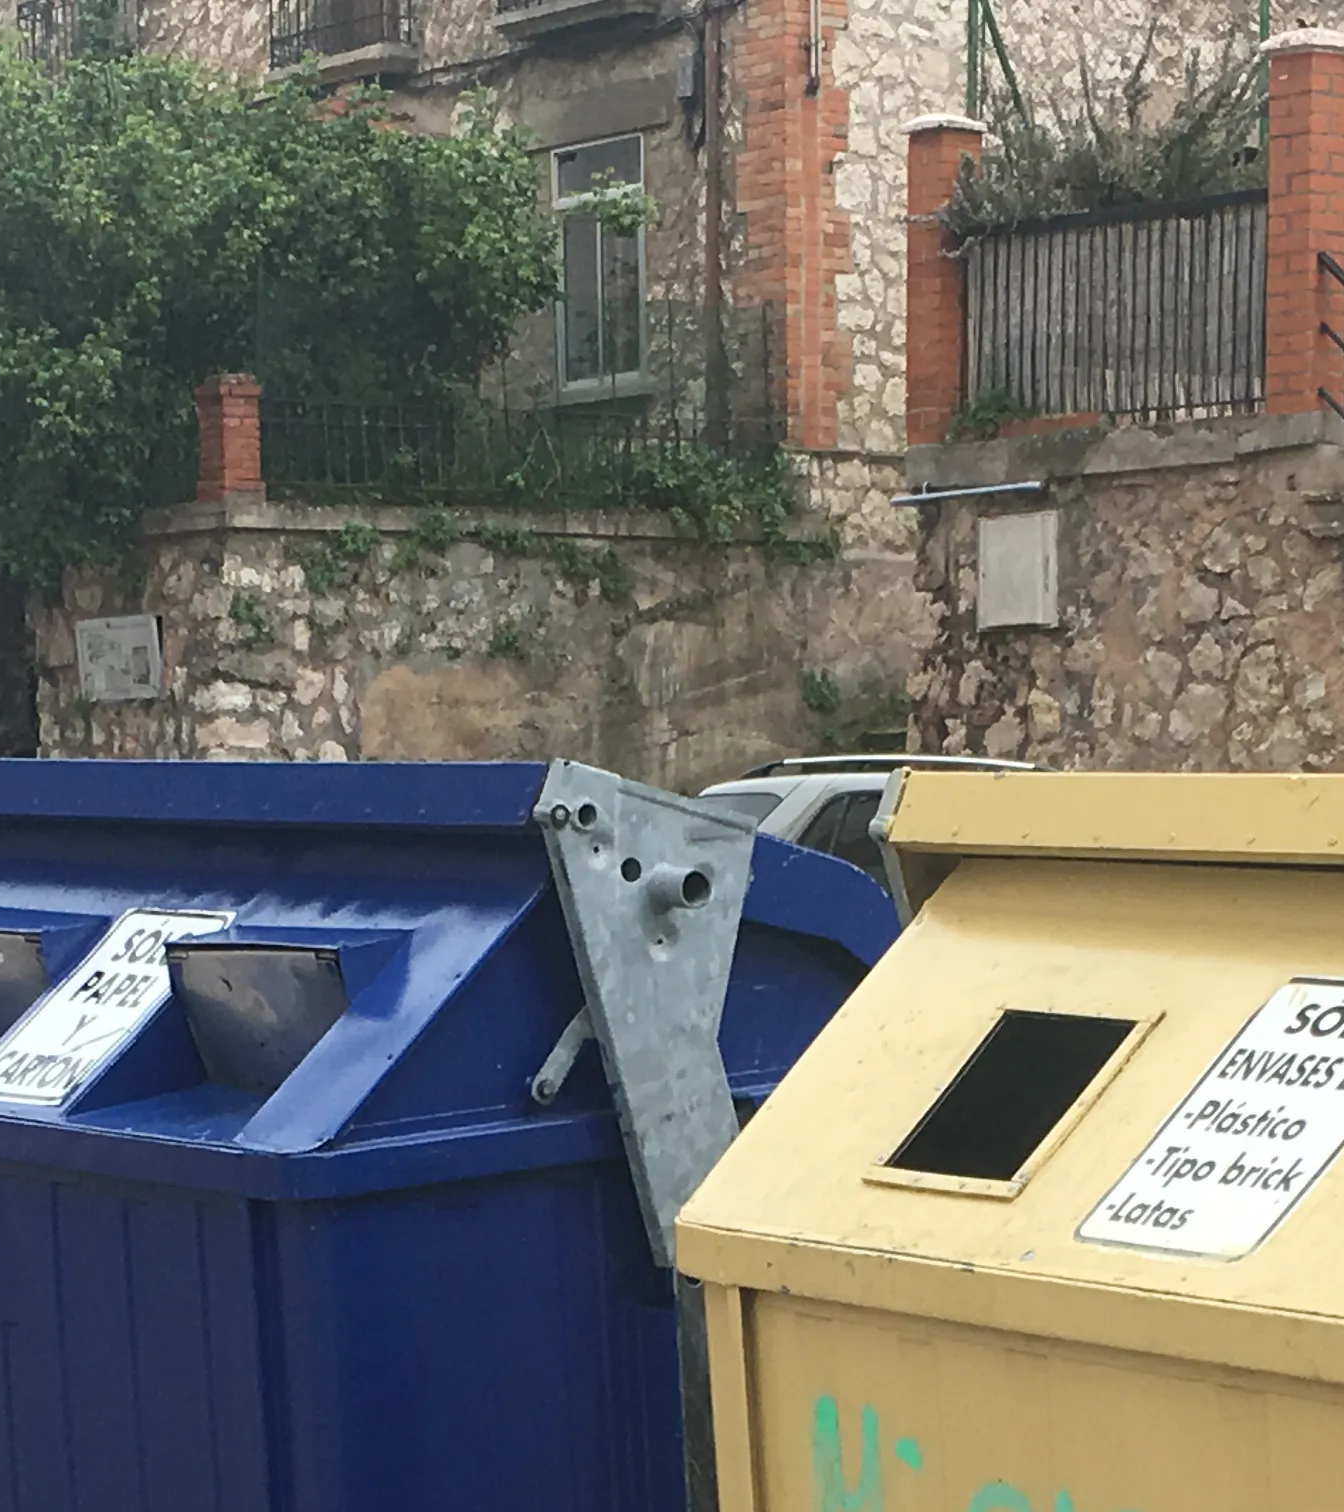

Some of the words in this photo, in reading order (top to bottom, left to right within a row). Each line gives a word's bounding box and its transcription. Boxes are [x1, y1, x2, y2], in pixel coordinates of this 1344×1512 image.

[111, 917, 172, 966] SÓL
[68, 971, 159, 1009] PAPEL
[60, 1014, 99, 1047] Y
[1182, 1098, 1308, 1141] -Plástico
[1145, 1146, 1217, 1189] -Tipo
[1217, 1152, 1304, 1193] brick
[1106, 1192, 1196, 1231] -Latas
